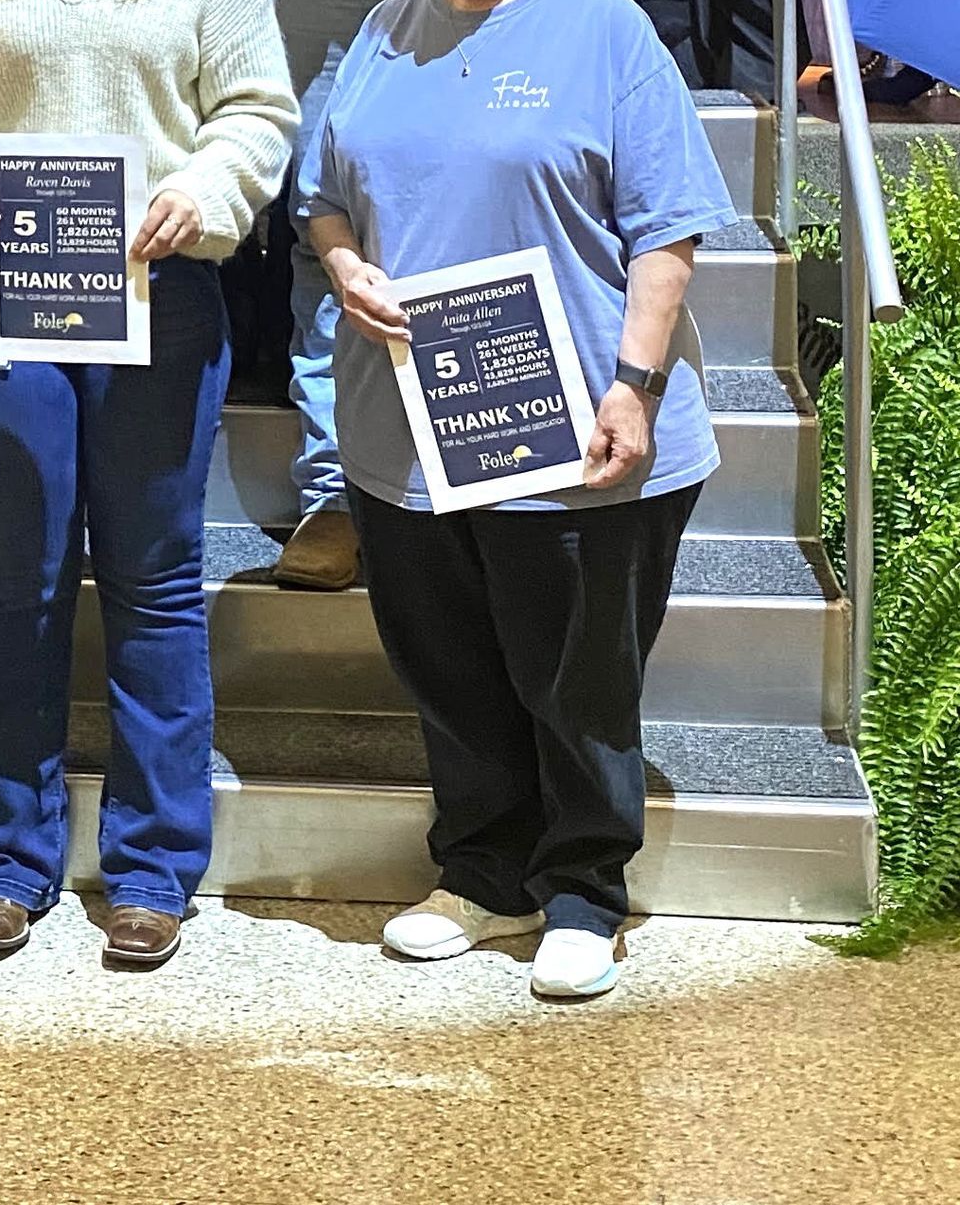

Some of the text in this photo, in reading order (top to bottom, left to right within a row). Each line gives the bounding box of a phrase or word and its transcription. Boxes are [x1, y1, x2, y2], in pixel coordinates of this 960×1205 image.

[491, 69, 549, 104] Foley
[486, 99, 551, 109] ALABAMA
[0, 160, 116, 171] HAPPY ANNIVERSARY
[26, 176, 91, 187] Raven Davis
[70, 207, 115, 215] MONTHS
[78, 217, 112, 225] WEEKS
[13, 210, 36, 236] 5
[57, 226, 121, 237] 1,826 DAYS
[1, 242, 49, 253] YEARS
[86, 238, 116, 246] HOURS
[0, 271, 122, 290] THANK YOU
[405, 281, 528, 317] HAPPY ANNIVERSARY
[33, 311, 70, 331] Foley
[439, 303, 502, 327] Anita Allen
[475, 328, 538, 349] 60 MONTHS
[477, 339, 537, 359] 261 WEEKS
[480, 347, 550, 371] 1,826 DAYS
[431, 350, 462, 381] 5
[483, 360, 547, 381] 43,829 HOURS
[519, 369, 551, 381] MINUTES
[426, 380, 479, 401] YEARS
[433, 393, 565, 437] THANK YOU
[477, 446, 521, 474] Foley
